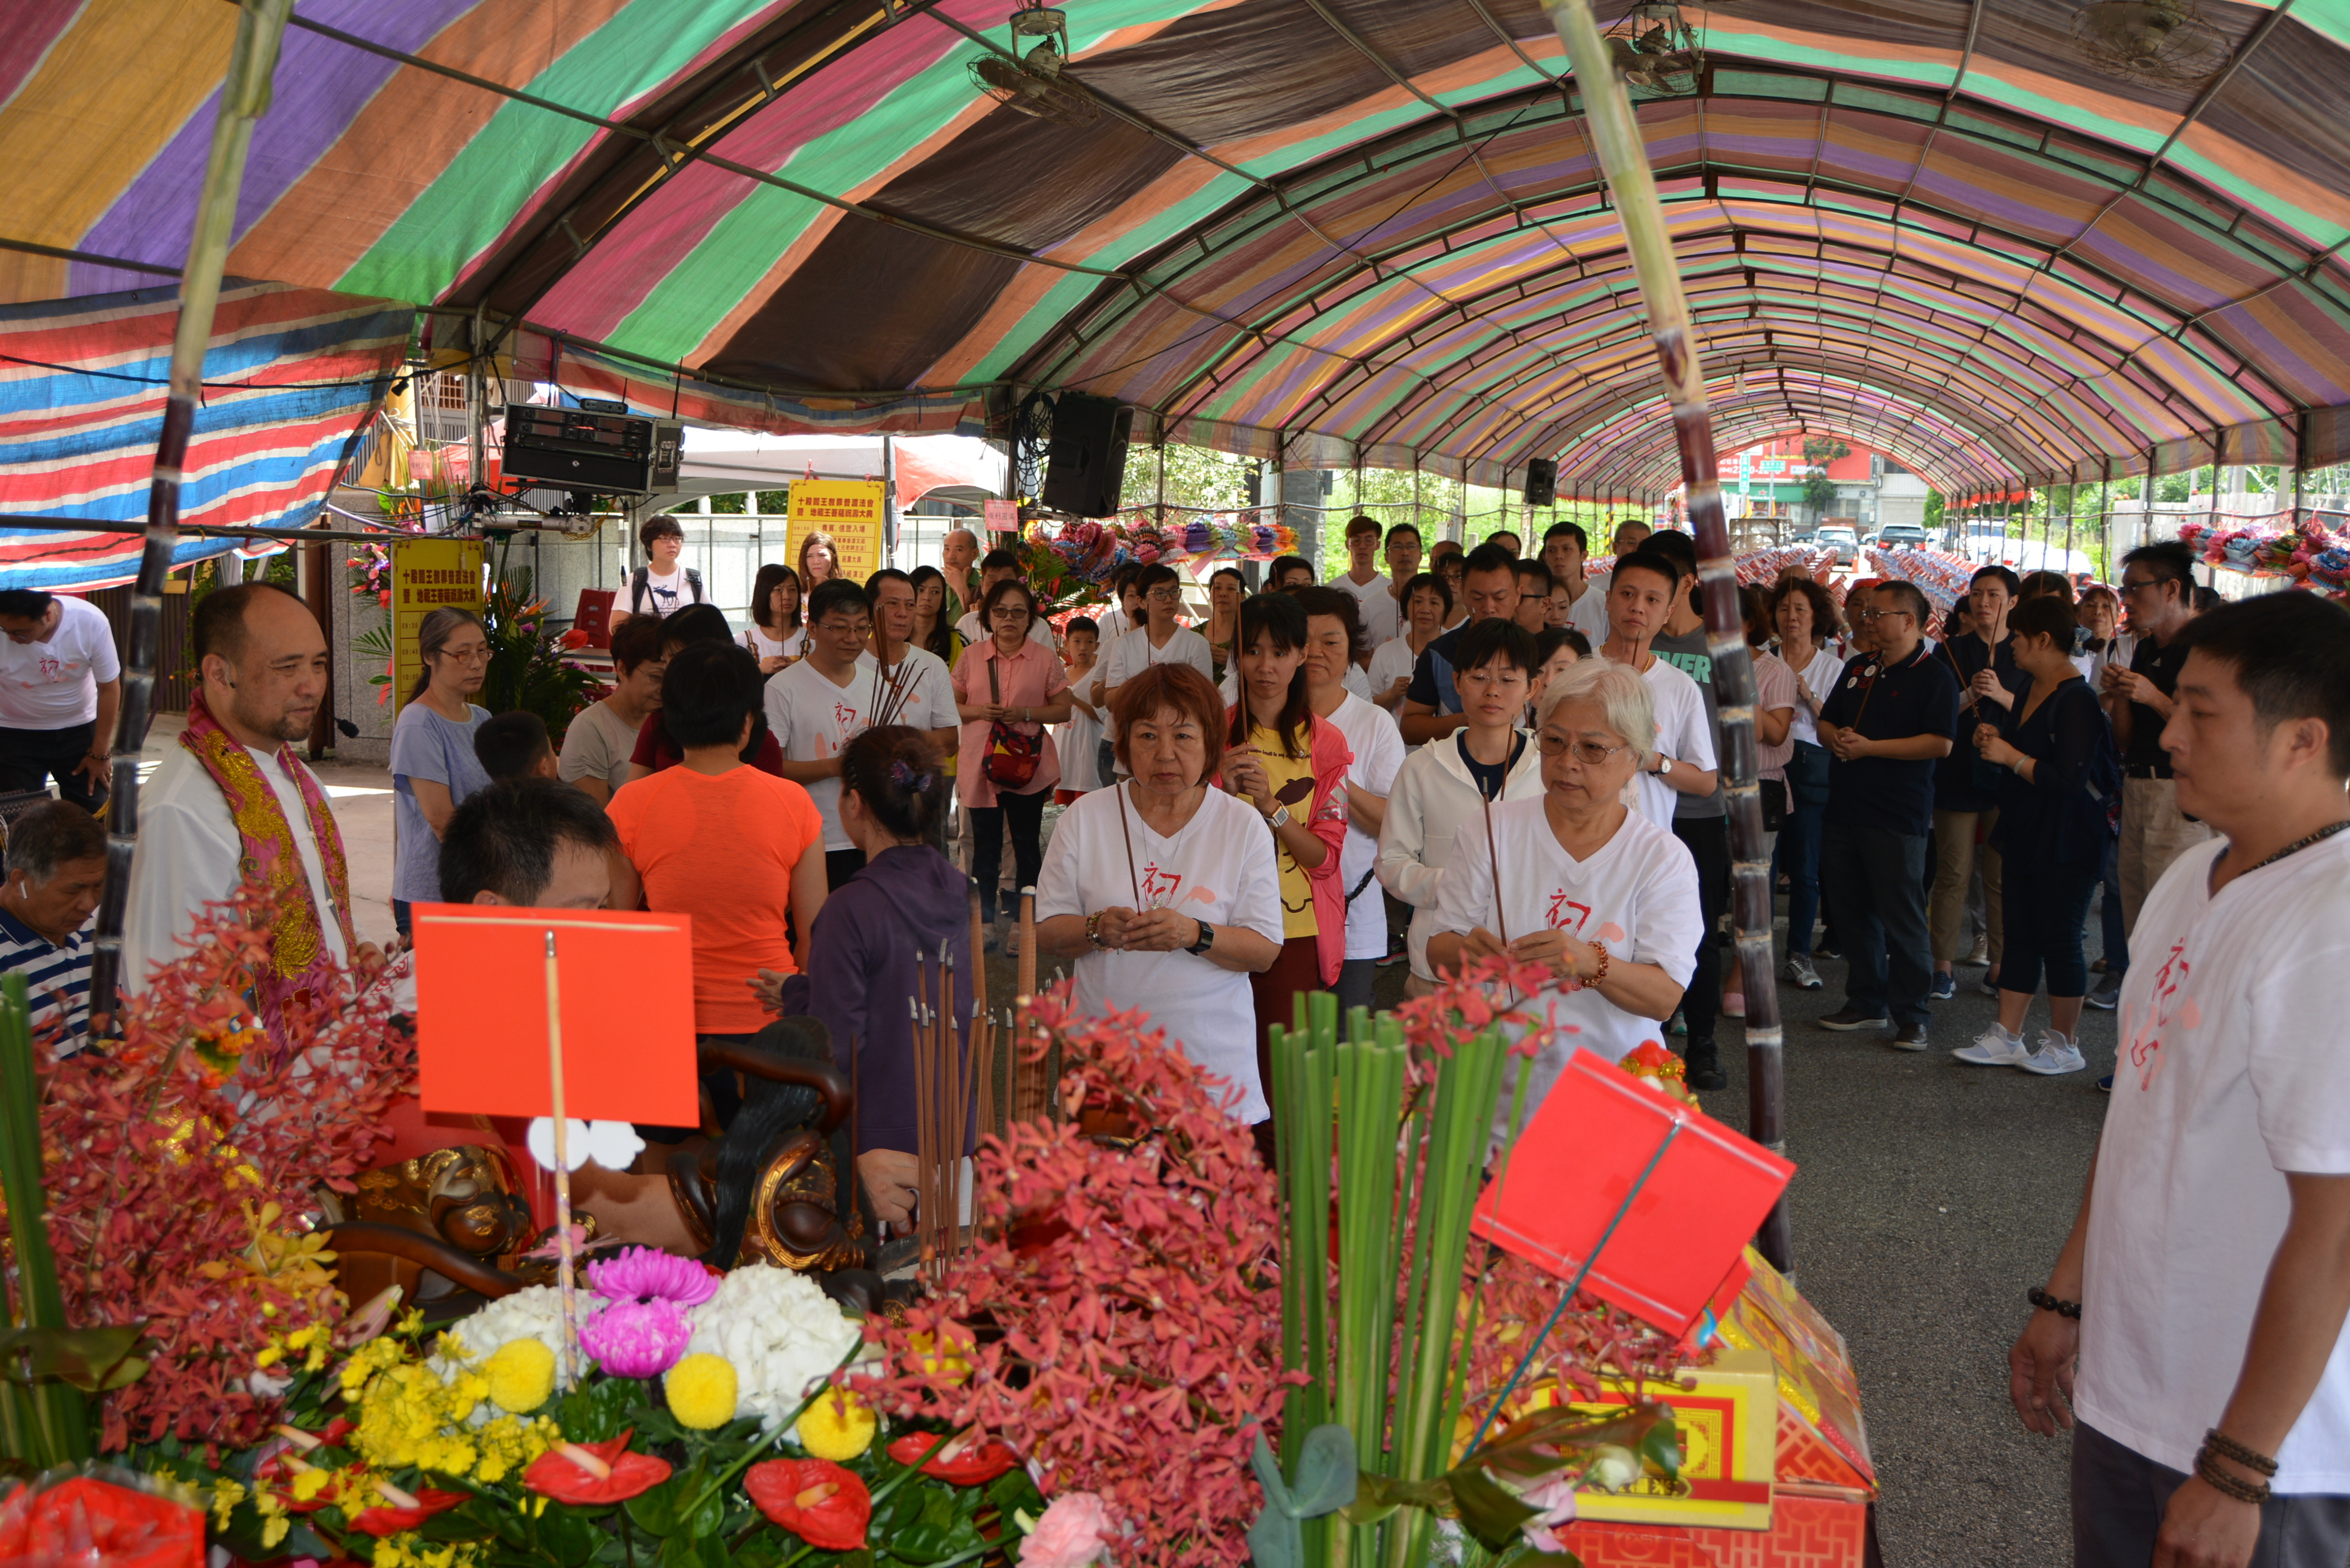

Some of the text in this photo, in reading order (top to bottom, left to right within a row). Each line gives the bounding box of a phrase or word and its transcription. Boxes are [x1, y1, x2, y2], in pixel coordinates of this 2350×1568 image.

[417, 588, 476, 603] 地藏王菩薩祝壽大典
